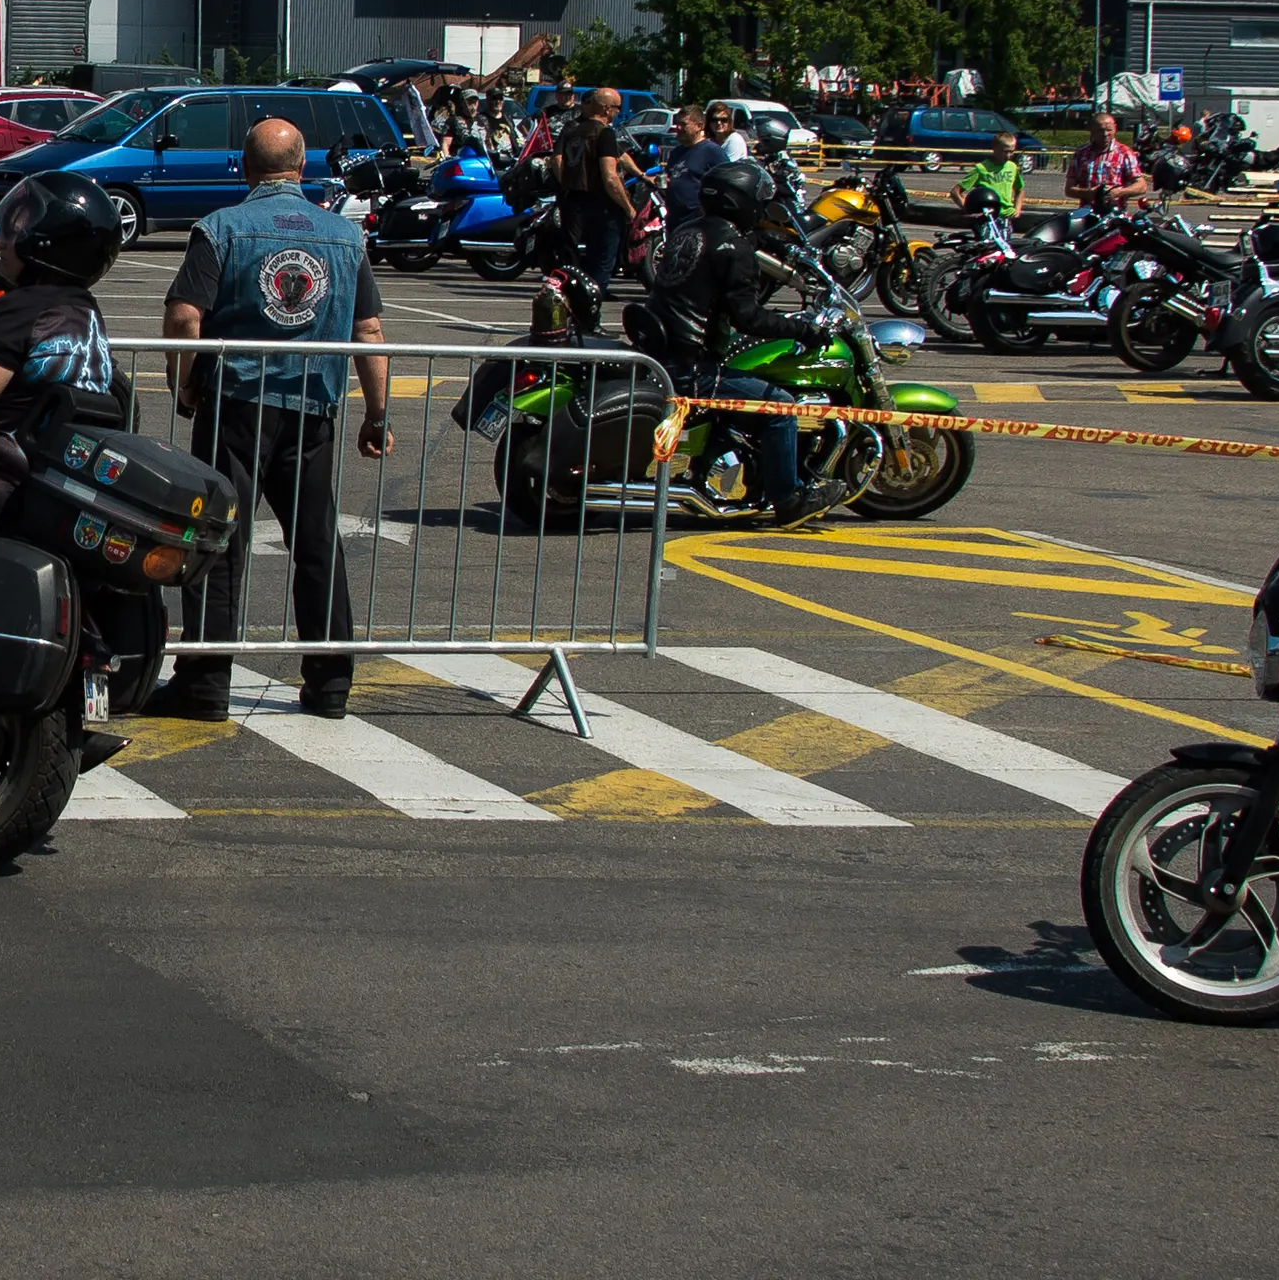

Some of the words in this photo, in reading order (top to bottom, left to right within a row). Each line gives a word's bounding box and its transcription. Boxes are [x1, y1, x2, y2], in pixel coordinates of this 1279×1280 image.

[268, 251, 301, 272] FOREVER
[302, 256, 322, 278] FREE
[765, 401, 823, 419] STOP
[836, 406, 894, 424] STOP
[911, 413, 970, 431] STOP
[980, 419, 1040, 436] STOP
[1054, 424, 1116, 442] STOP
[1124, 431, 1184, 448] STOP
[1198, 438, 1259, 456] STOP
